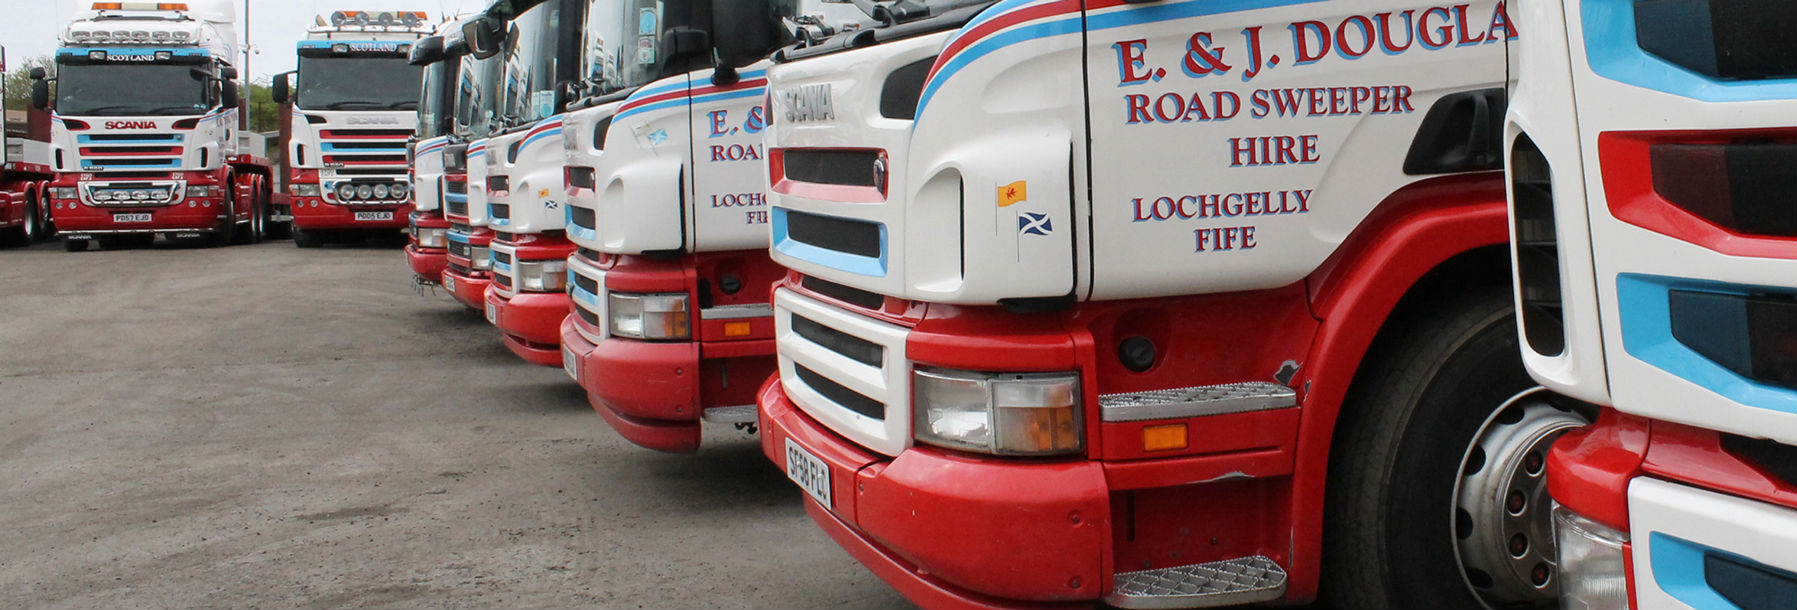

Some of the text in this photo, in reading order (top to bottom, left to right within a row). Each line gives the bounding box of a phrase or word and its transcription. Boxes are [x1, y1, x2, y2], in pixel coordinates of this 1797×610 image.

[106, 54, 155, 62] SCOTLAND
[349, 43, 398, 52] SCOTLAND
[1112, 2, 1519, 87] E. & J. DOUGLA
[784, 83, 835, 122] SCANIA
[1124, 84, 1415, 124] ROAD SWEEPER
[105, 121, 157, 130] SCANIA
[706, 109, 739, 138] E.
[709, 143, 764, 162] ROA
[1227, 134, 1320, 168] HIRE
[1131, 189, 1313, 223] LOCHGELLY
[1193, 226, 1257, 253] FIFE
[789, 446, 827, 500] SF58 FLC
